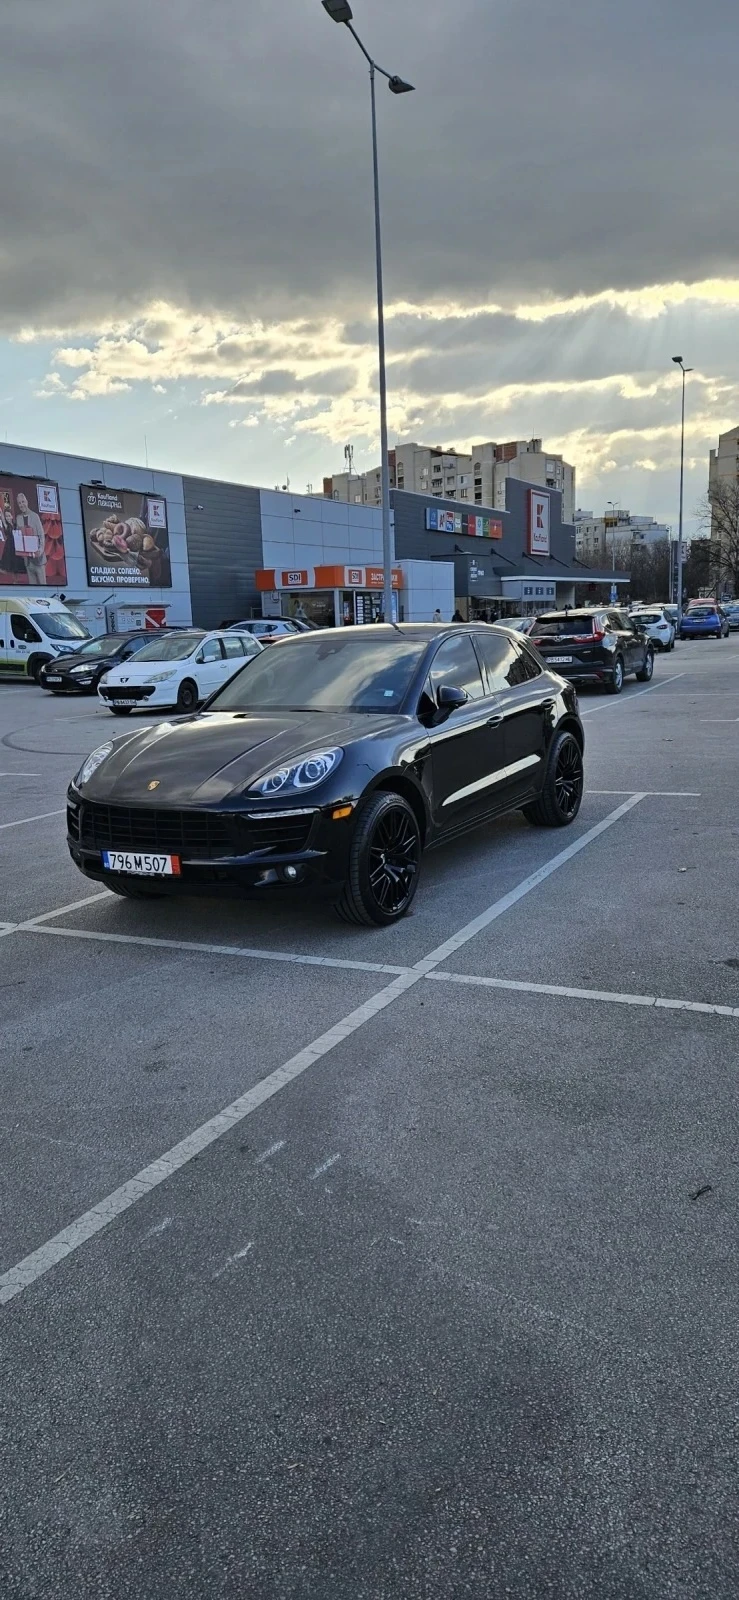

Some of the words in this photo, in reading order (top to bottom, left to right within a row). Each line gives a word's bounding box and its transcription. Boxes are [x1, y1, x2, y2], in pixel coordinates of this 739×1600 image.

[97, 493, 118, 501] Kaufland
[536, 504, 544, 529] K
[533, 532, 548, 543] Kaufland
[90, 566, 117, 575] СЛАДКО.
[118, 567, 142, 575] СОЛЕНО.
[91, 575, 116, 583] ВКУСНО.
[116, 576, 151, 584] ПРОВЕРЕНО.
[289, 574, 301, 582] SDI
[351, 572, 359, 580] SDI
